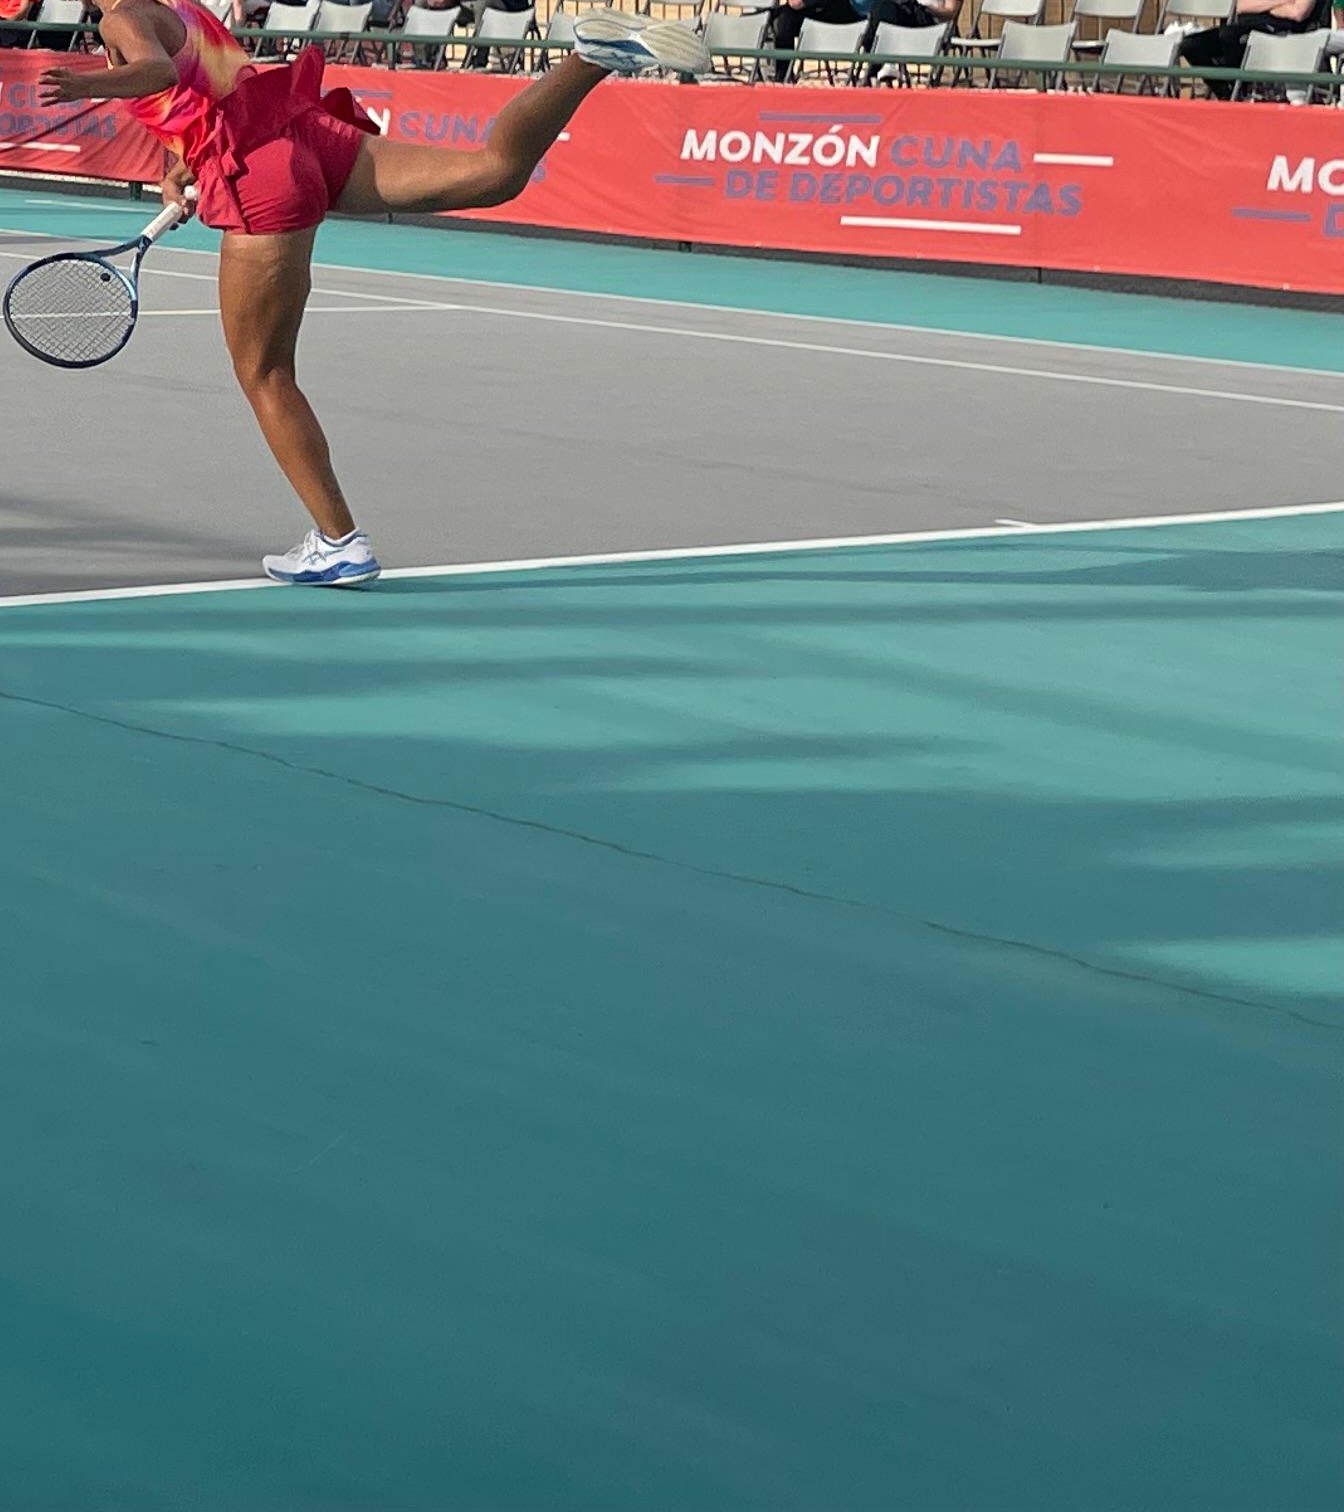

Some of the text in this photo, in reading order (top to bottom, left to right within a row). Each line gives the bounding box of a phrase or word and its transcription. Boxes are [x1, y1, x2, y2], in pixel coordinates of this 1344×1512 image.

[680, 125, 1023, 174] MONZÓN CUNA
[724, 169, 1084, 217] DE DEPORTISTAS
